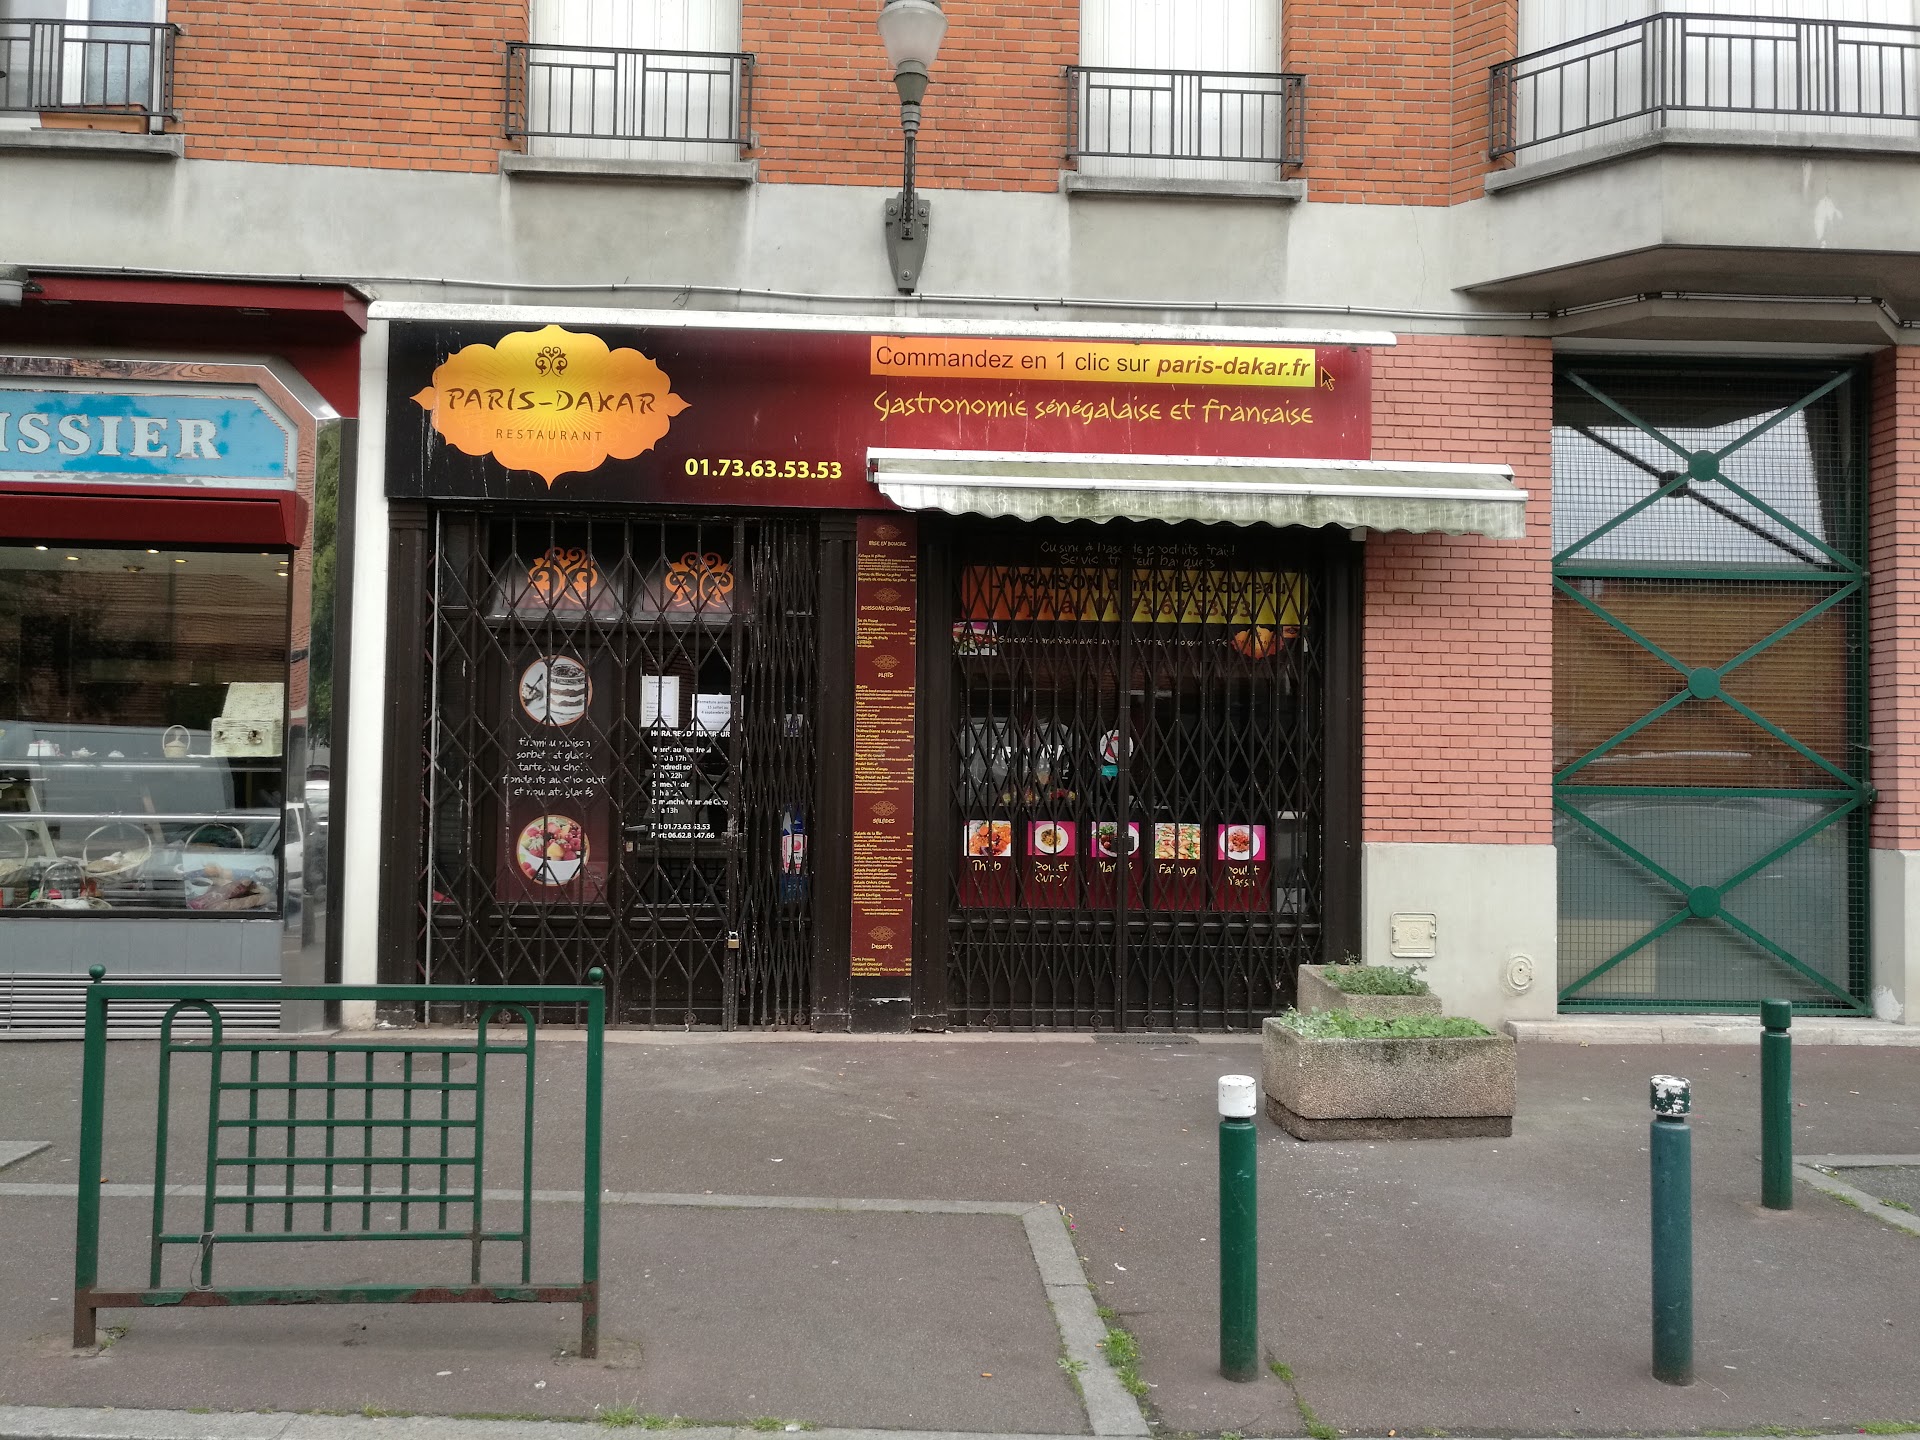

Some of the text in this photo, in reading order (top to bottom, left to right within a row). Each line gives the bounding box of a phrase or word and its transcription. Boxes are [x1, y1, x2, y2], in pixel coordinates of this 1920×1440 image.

[875, 345, 1312, 379] Commandez en 1 clic sur paris-dakar.fr
[445, 387, 657, 415] PARIS-DAKAR
[1034, 398, 1163, 426] sénégalaise
[1169, 400, 1196, 422] et
[1201, 400, 1315, 426] française
[495, 428, 603, 442] RESTAURANT
[684, 458, 843, 480] 01.73.63.53.53
[1040, 541, 1079, 554] Cusine
[652, 763, 682, 771] Vndredi
[651, 780, 677, 788] Smedi
[651, 822, 663, 830] Tl:
[972, 859, 1002, 872] Thb
[871, 942, 894, 950] Desserts
